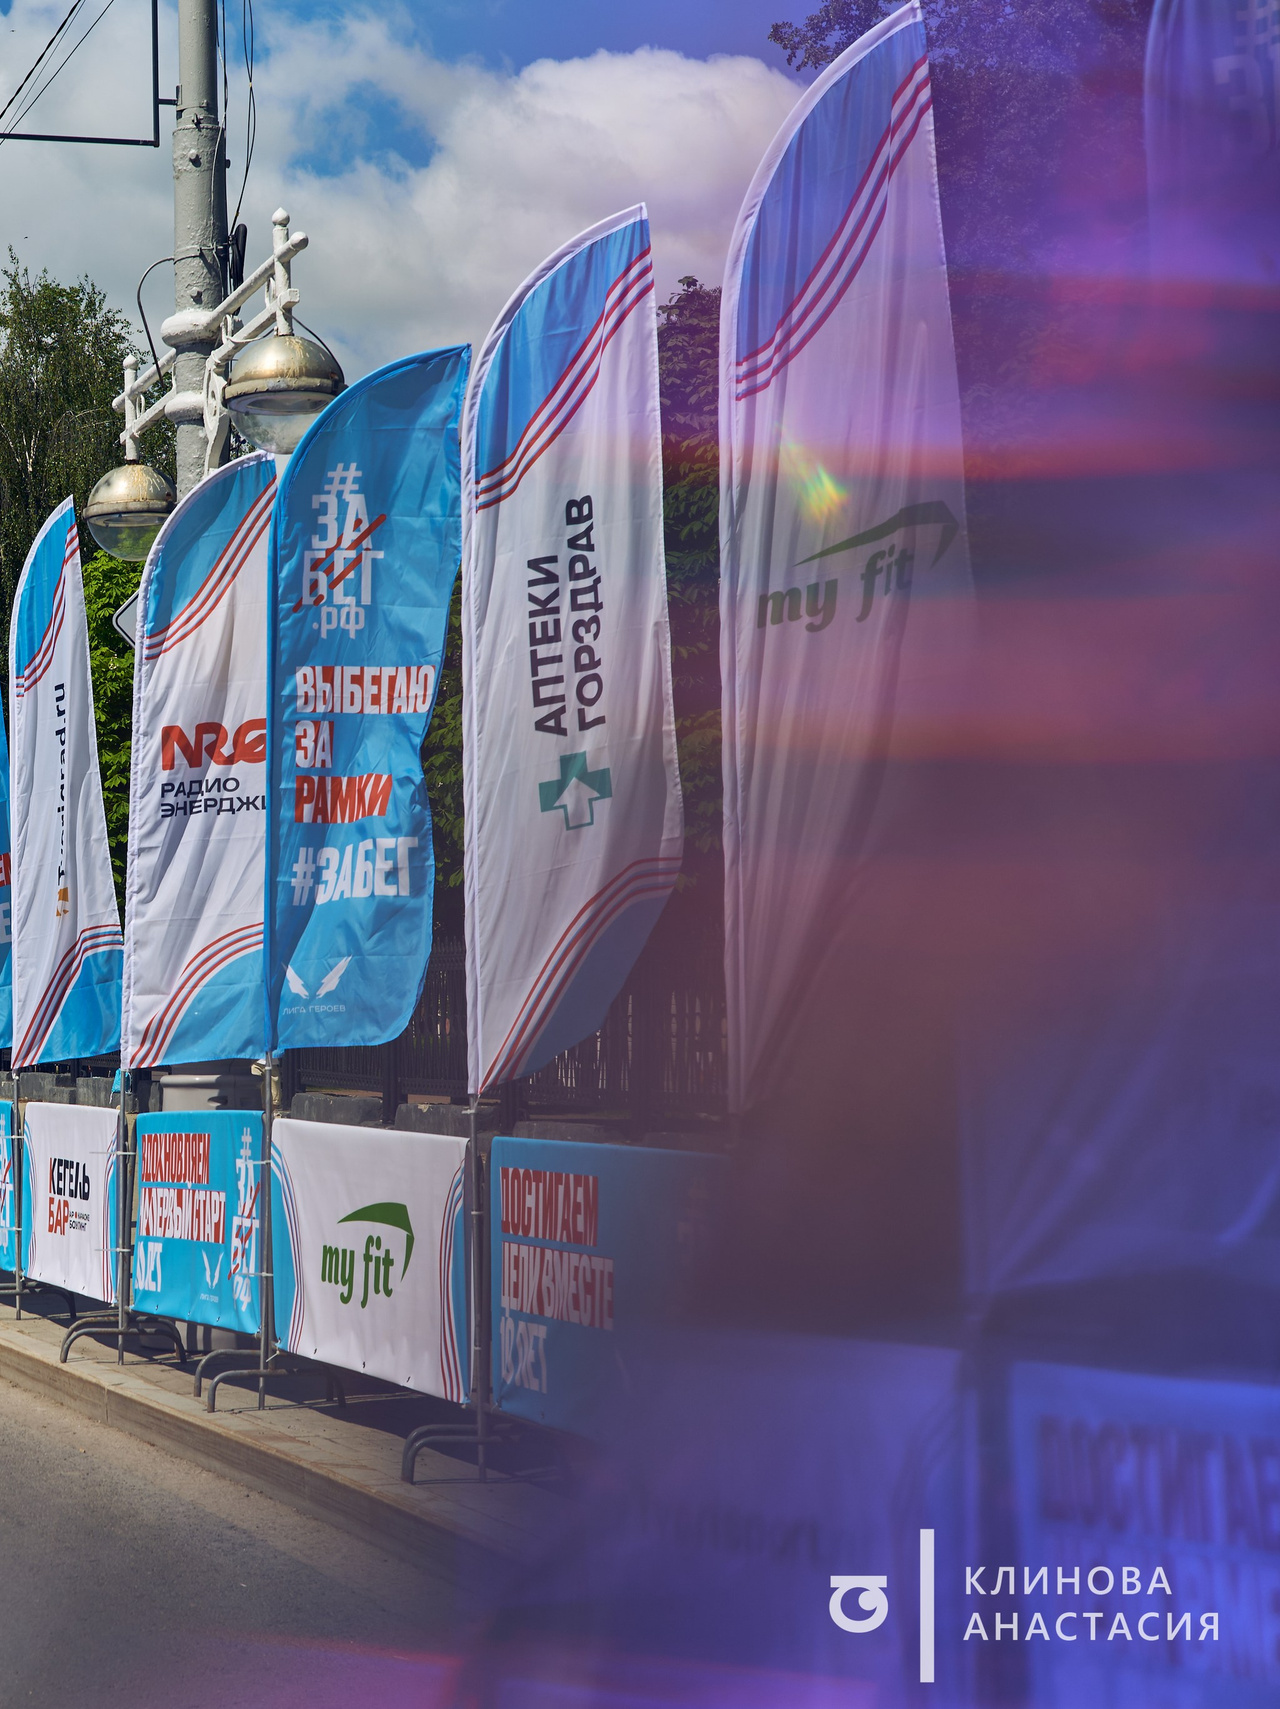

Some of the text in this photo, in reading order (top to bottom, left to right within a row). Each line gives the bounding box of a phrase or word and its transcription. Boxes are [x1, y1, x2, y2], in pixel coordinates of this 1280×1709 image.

[565, 495, 606, 731] ГОРЗДРАВ
[757, 543, 915, 633] my fit
[527, 555, 568, 736] АПТЕКИ
[296, 665, 435, 714] ВЫБЕГАЮ
[296, 720, 334, 768] ЗА
[161, 777, 240, 798] РАДИО
[295, 773, 393, 824] РАМКИ
[291, 837, 418, 906] #ЗАБЕГ
[283, 1004, 346, 1015] ЛИГА ГЕРОЕВ
[49, 1157, 90, 1201] КЕГЕЛЬ
[142, 1133, 210, 1184] ВДОХНОВЛЯЕМ
[48, 1196, 69, 1236] БАР
[192, 1190, 226, 1244] СТАРТ
[500, 1167, 599, 1247] ДОСТИГАЕМ
[321, 1235, 394, 1309] my fit
[501, 1241, 614, 1331] ЦЕЛИ ВМЕСТЕ
